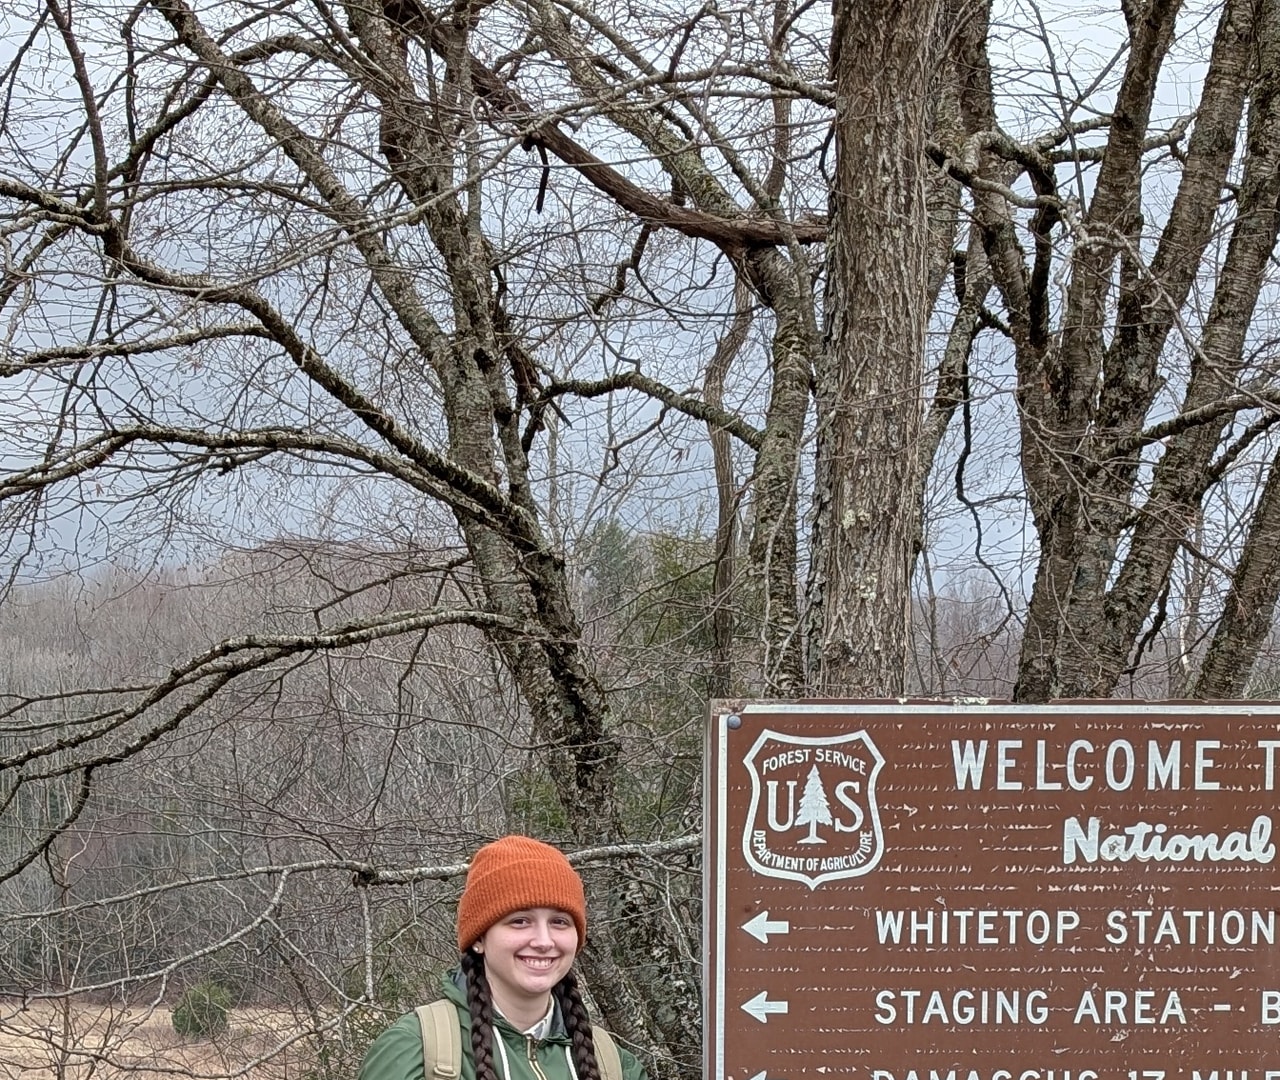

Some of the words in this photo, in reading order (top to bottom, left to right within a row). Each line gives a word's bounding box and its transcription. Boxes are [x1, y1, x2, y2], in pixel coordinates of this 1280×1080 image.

[762, 748, 812, 776] FOREST
[815, 748, 867, 776] SERVICE
[950, 739, 1223, 792] WELCOME
[752, 829, 805, 871] DEPARTMENT
[806, 857, 820, 871] OF
[820, 829, 873, 871] AGRICULTURE
[1063, 815, 1276, 864] National
[875, 910, 1081, 945] WHITETOP
[1105, 910, 1275, 945] STATION
[873, 989, 1050, 1025] STAGING
[1073, 989, 1187, 1025] AREA
